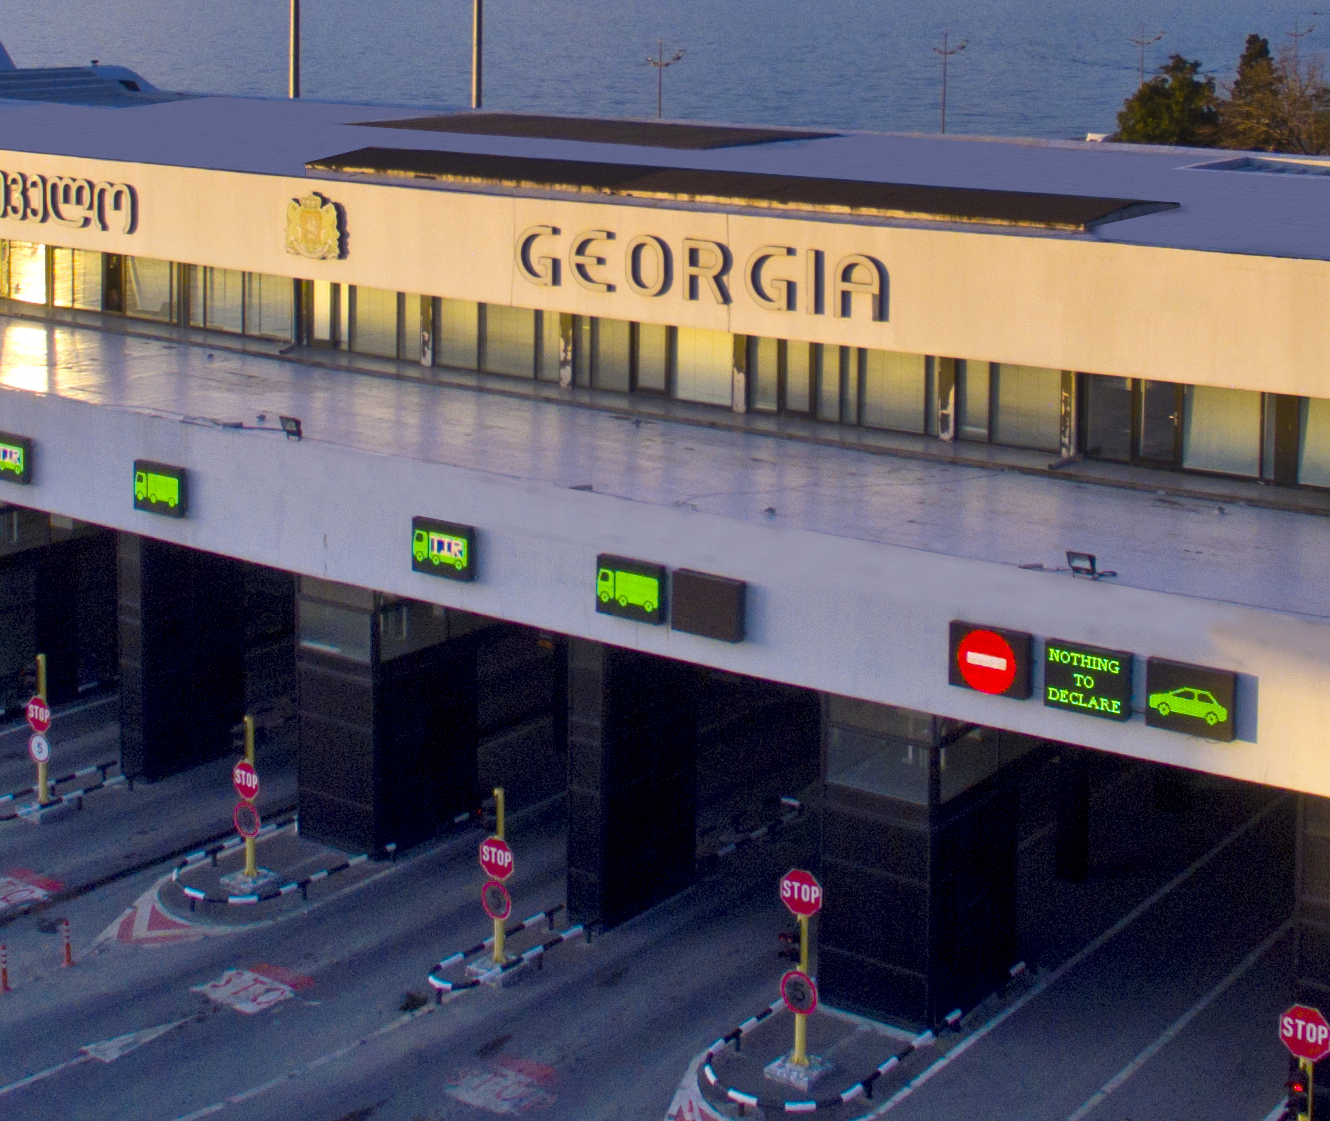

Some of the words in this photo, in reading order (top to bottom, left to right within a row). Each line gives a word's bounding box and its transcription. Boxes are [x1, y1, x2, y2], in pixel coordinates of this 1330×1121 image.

[515, 225, 891, 323] GEORGIA
[1049, 648, 1120, 674] NOTHING
[1073, 673, 1094, 689] TO
[1048, 687, 1121, 714] DECLARE
[28, 704, 51, 723] STOP
[235, 768, 259, 790] STOP
[482, 844, 512, 868] STOP
[782, 879, 821, 904] STOP
[1282, 1016, 1329, 1046] STOP
